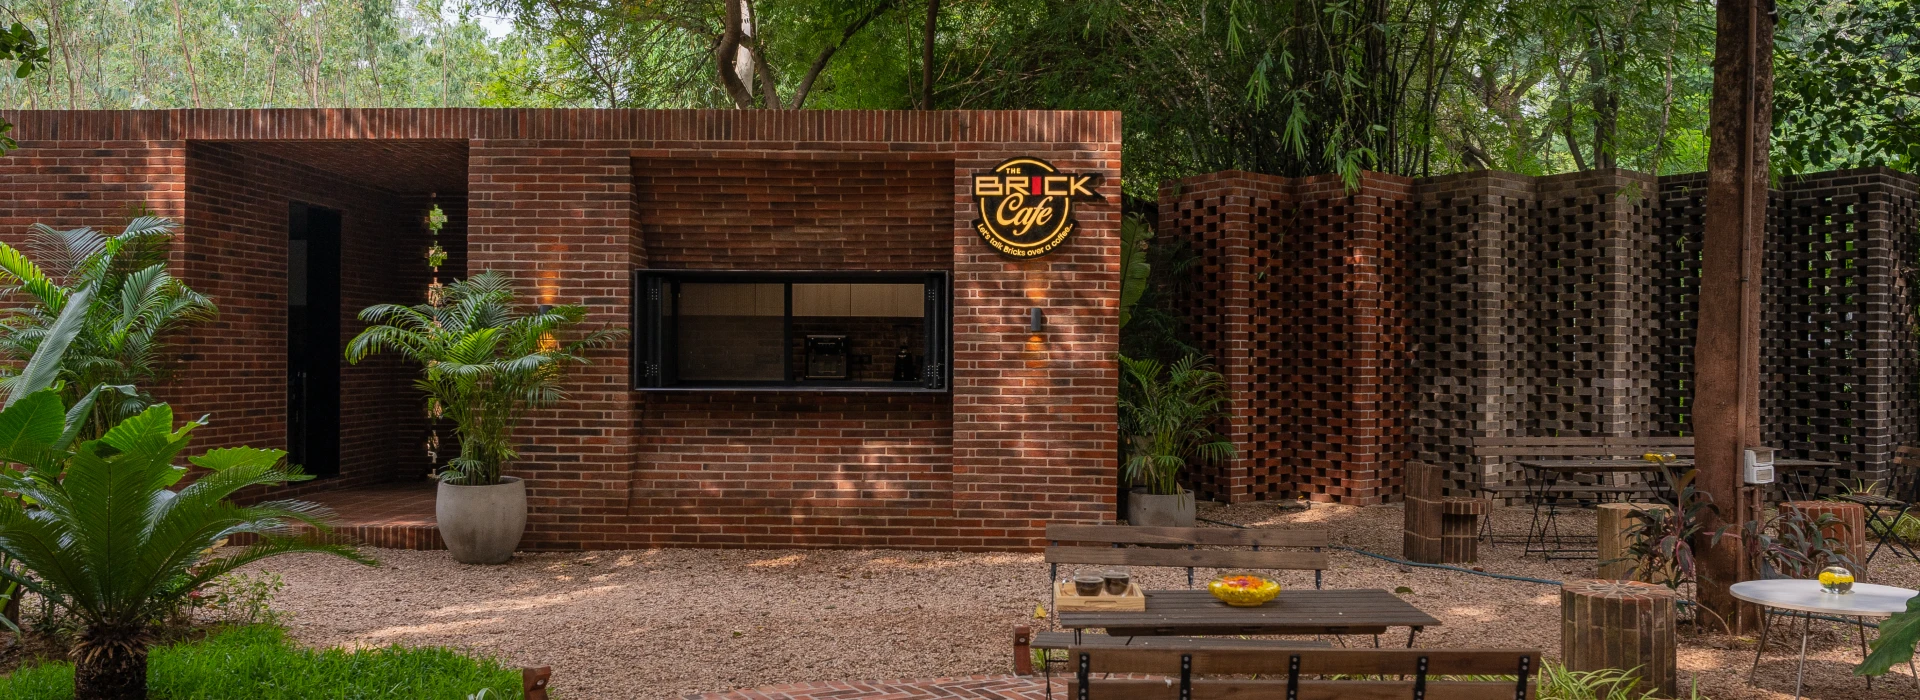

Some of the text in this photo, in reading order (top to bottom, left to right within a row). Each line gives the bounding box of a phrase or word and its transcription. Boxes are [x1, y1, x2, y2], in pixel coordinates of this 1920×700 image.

[975, 176, 1093, 195] BRICK
[996, 192, 1054, 236] Cafe
[977, 223, 991, 240] Let's
[990, 237, 1004, 250] talk
[1003, 245, 1026, 257] Bricks
[1027, 246, 1044, 256] over
